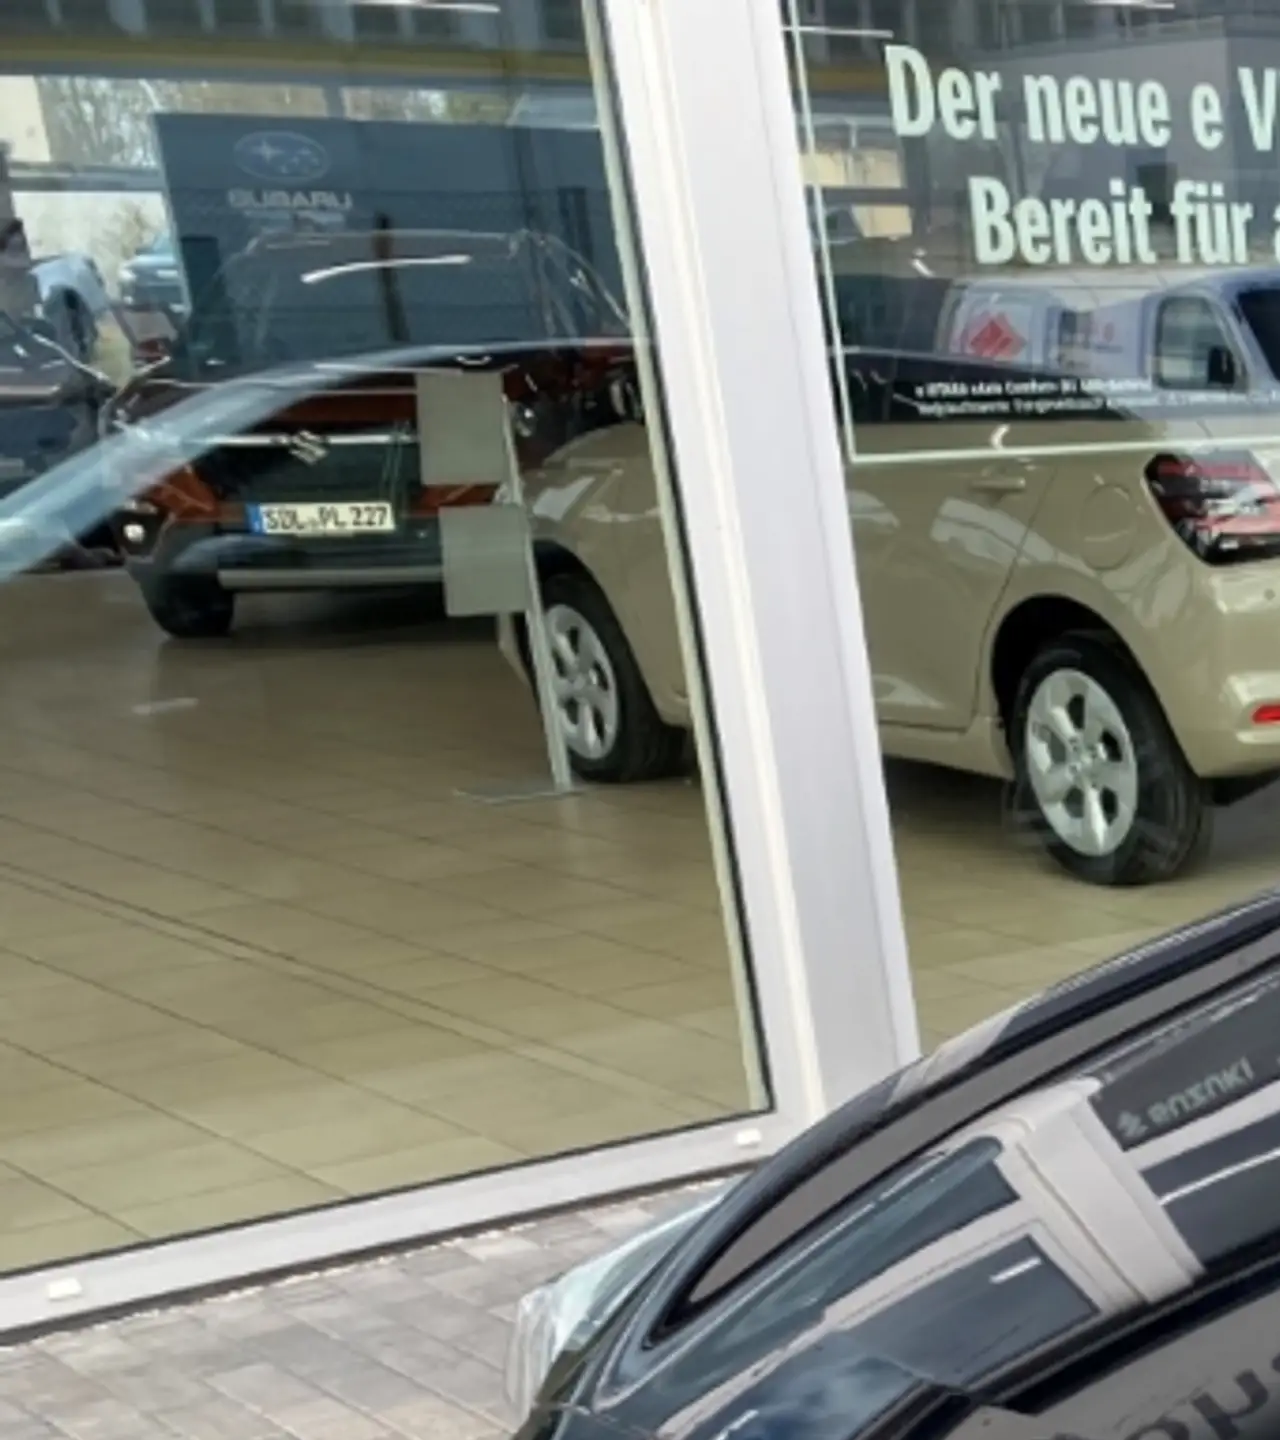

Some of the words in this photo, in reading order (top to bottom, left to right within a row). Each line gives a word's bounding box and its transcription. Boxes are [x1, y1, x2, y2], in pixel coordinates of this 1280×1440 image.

[885, 44, 1001, 139] Der
[1023, 74, 1171, 147] neue
[1191, 82, 1223, 150] e
[968, 176, 1156, 264] Bereit
[1170, 179, 1253, 264] für
